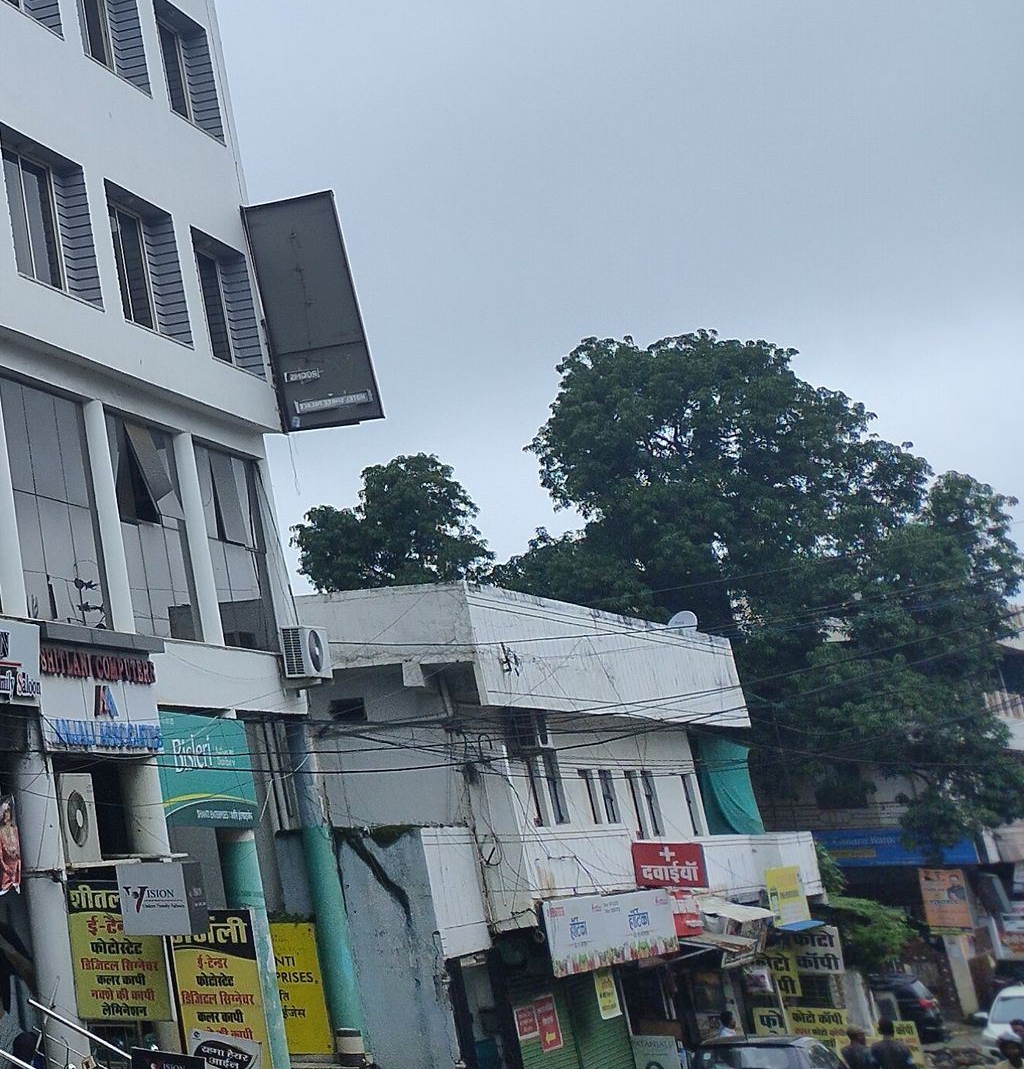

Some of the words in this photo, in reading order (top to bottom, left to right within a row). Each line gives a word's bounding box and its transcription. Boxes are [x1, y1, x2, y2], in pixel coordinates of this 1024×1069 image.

[172, 734, 213, 772] Bisleri
[123, 886, 175, 913] VISION
[90, 937, 143, 954] फोटोस्टेट
[796, 952, 841, 970] कॉपी
[96, 975, 121, 985] कलर
[117, 987, 129, 1000] की
[196, 1011, 220, 1023] कलर
